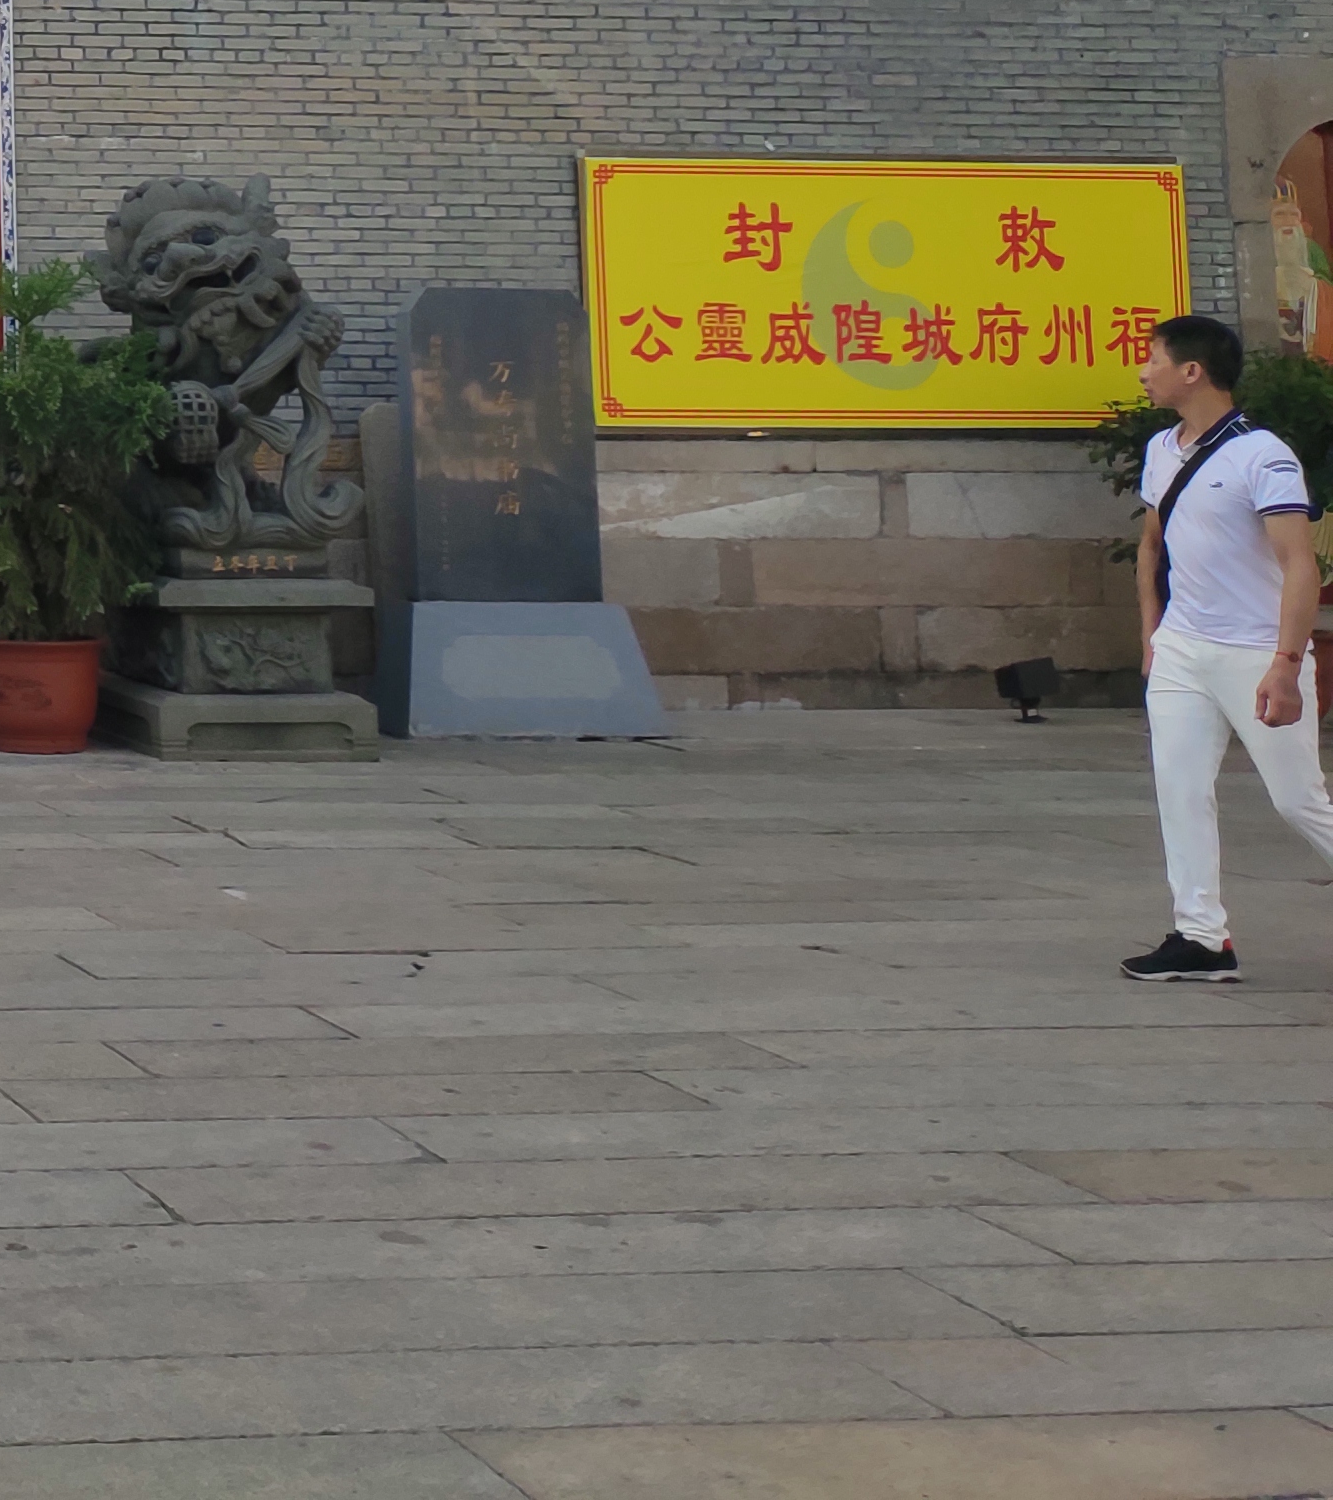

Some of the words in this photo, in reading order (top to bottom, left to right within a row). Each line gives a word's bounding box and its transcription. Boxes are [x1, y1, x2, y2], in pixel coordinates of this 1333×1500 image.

[722, 201, 1066, 274] 敕封
[619, 301, 1161, 368] 福州府城隍威靈公
